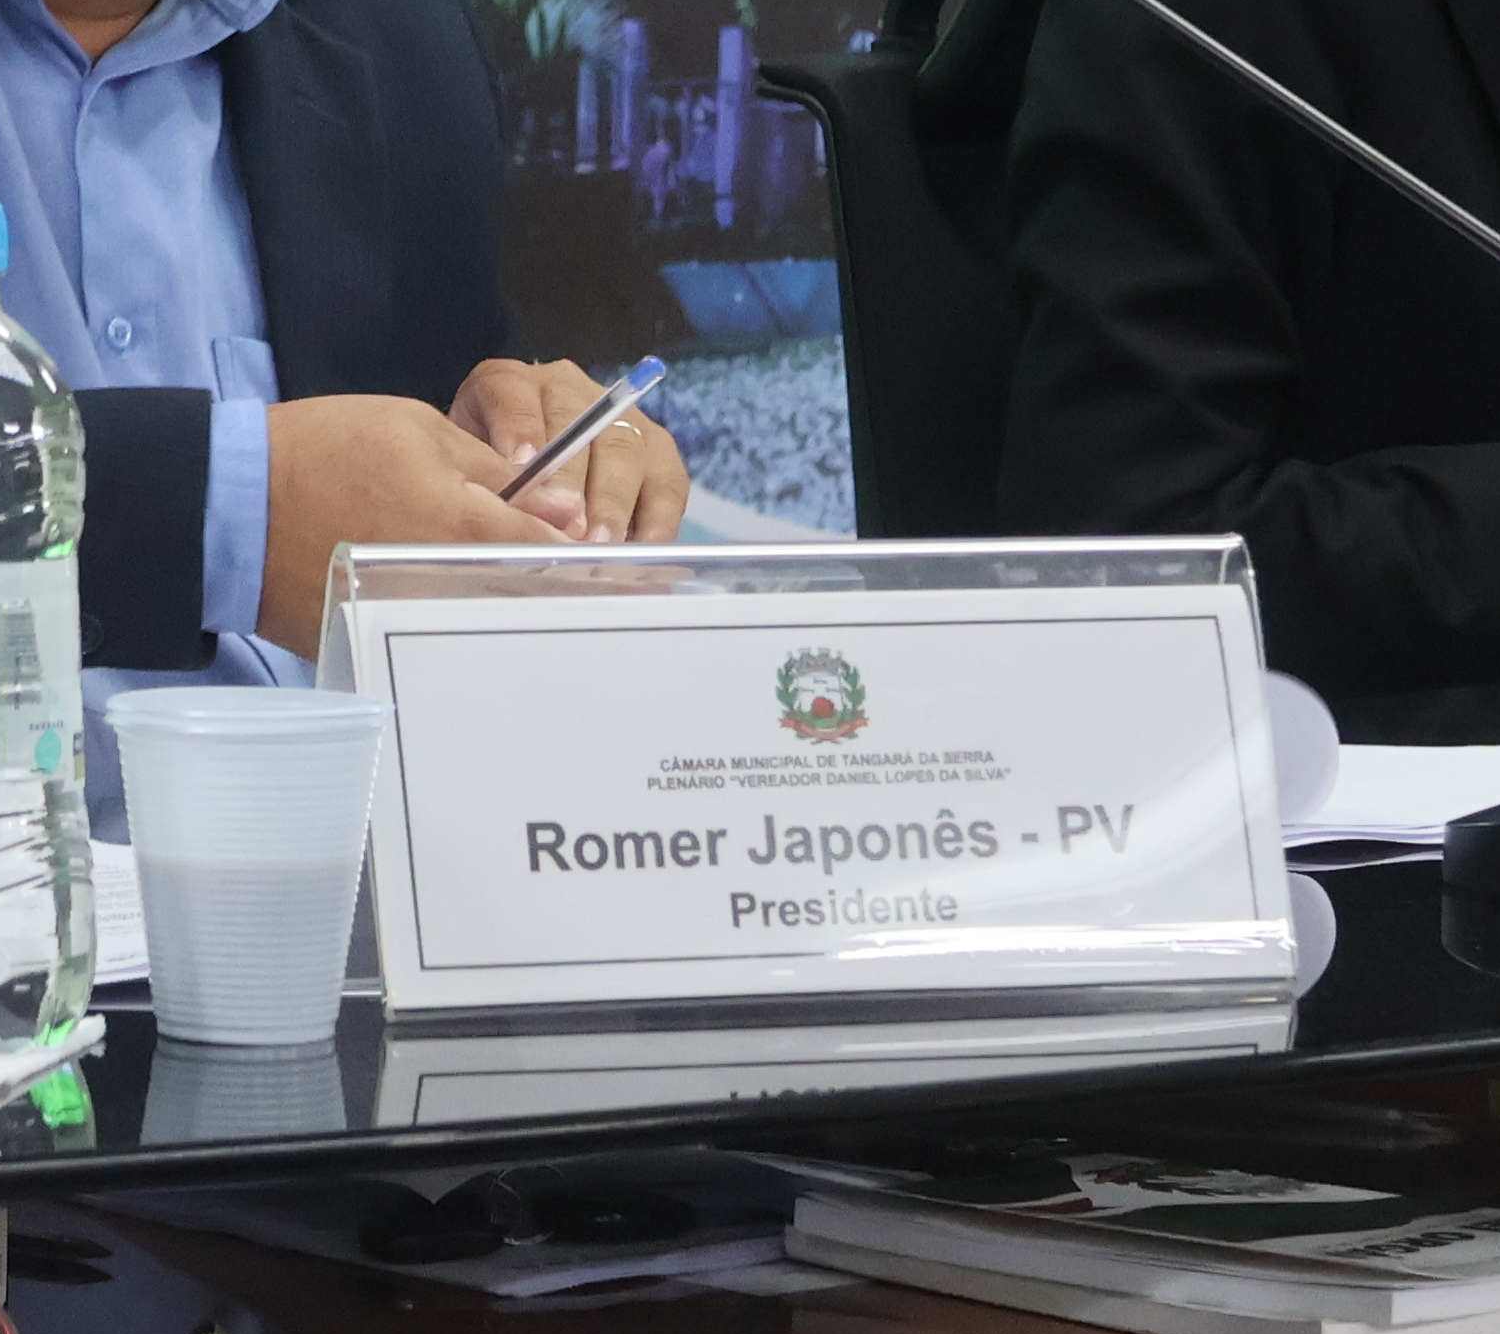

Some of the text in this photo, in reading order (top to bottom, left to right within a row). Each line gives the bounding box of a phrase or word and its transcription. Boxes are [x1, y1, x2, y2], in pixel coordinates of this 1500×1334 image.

[660, 750, 995, 773] CÂMARA MUNICIPAL DE TANGARÁ DA SERRA
[647, 773, 725, 790] PLENÁRIO
[826, 771, 880, 786] DANIEL
[885, 770, 936, 784] LOPES
[938, 769, 961, 782] DA
[525, 821, 728, 873] Romer
[747, 809, 999, 875] Japonês
[1057, 804, 1136, 855] PV
[729, 886, 959, 929] Presidente
